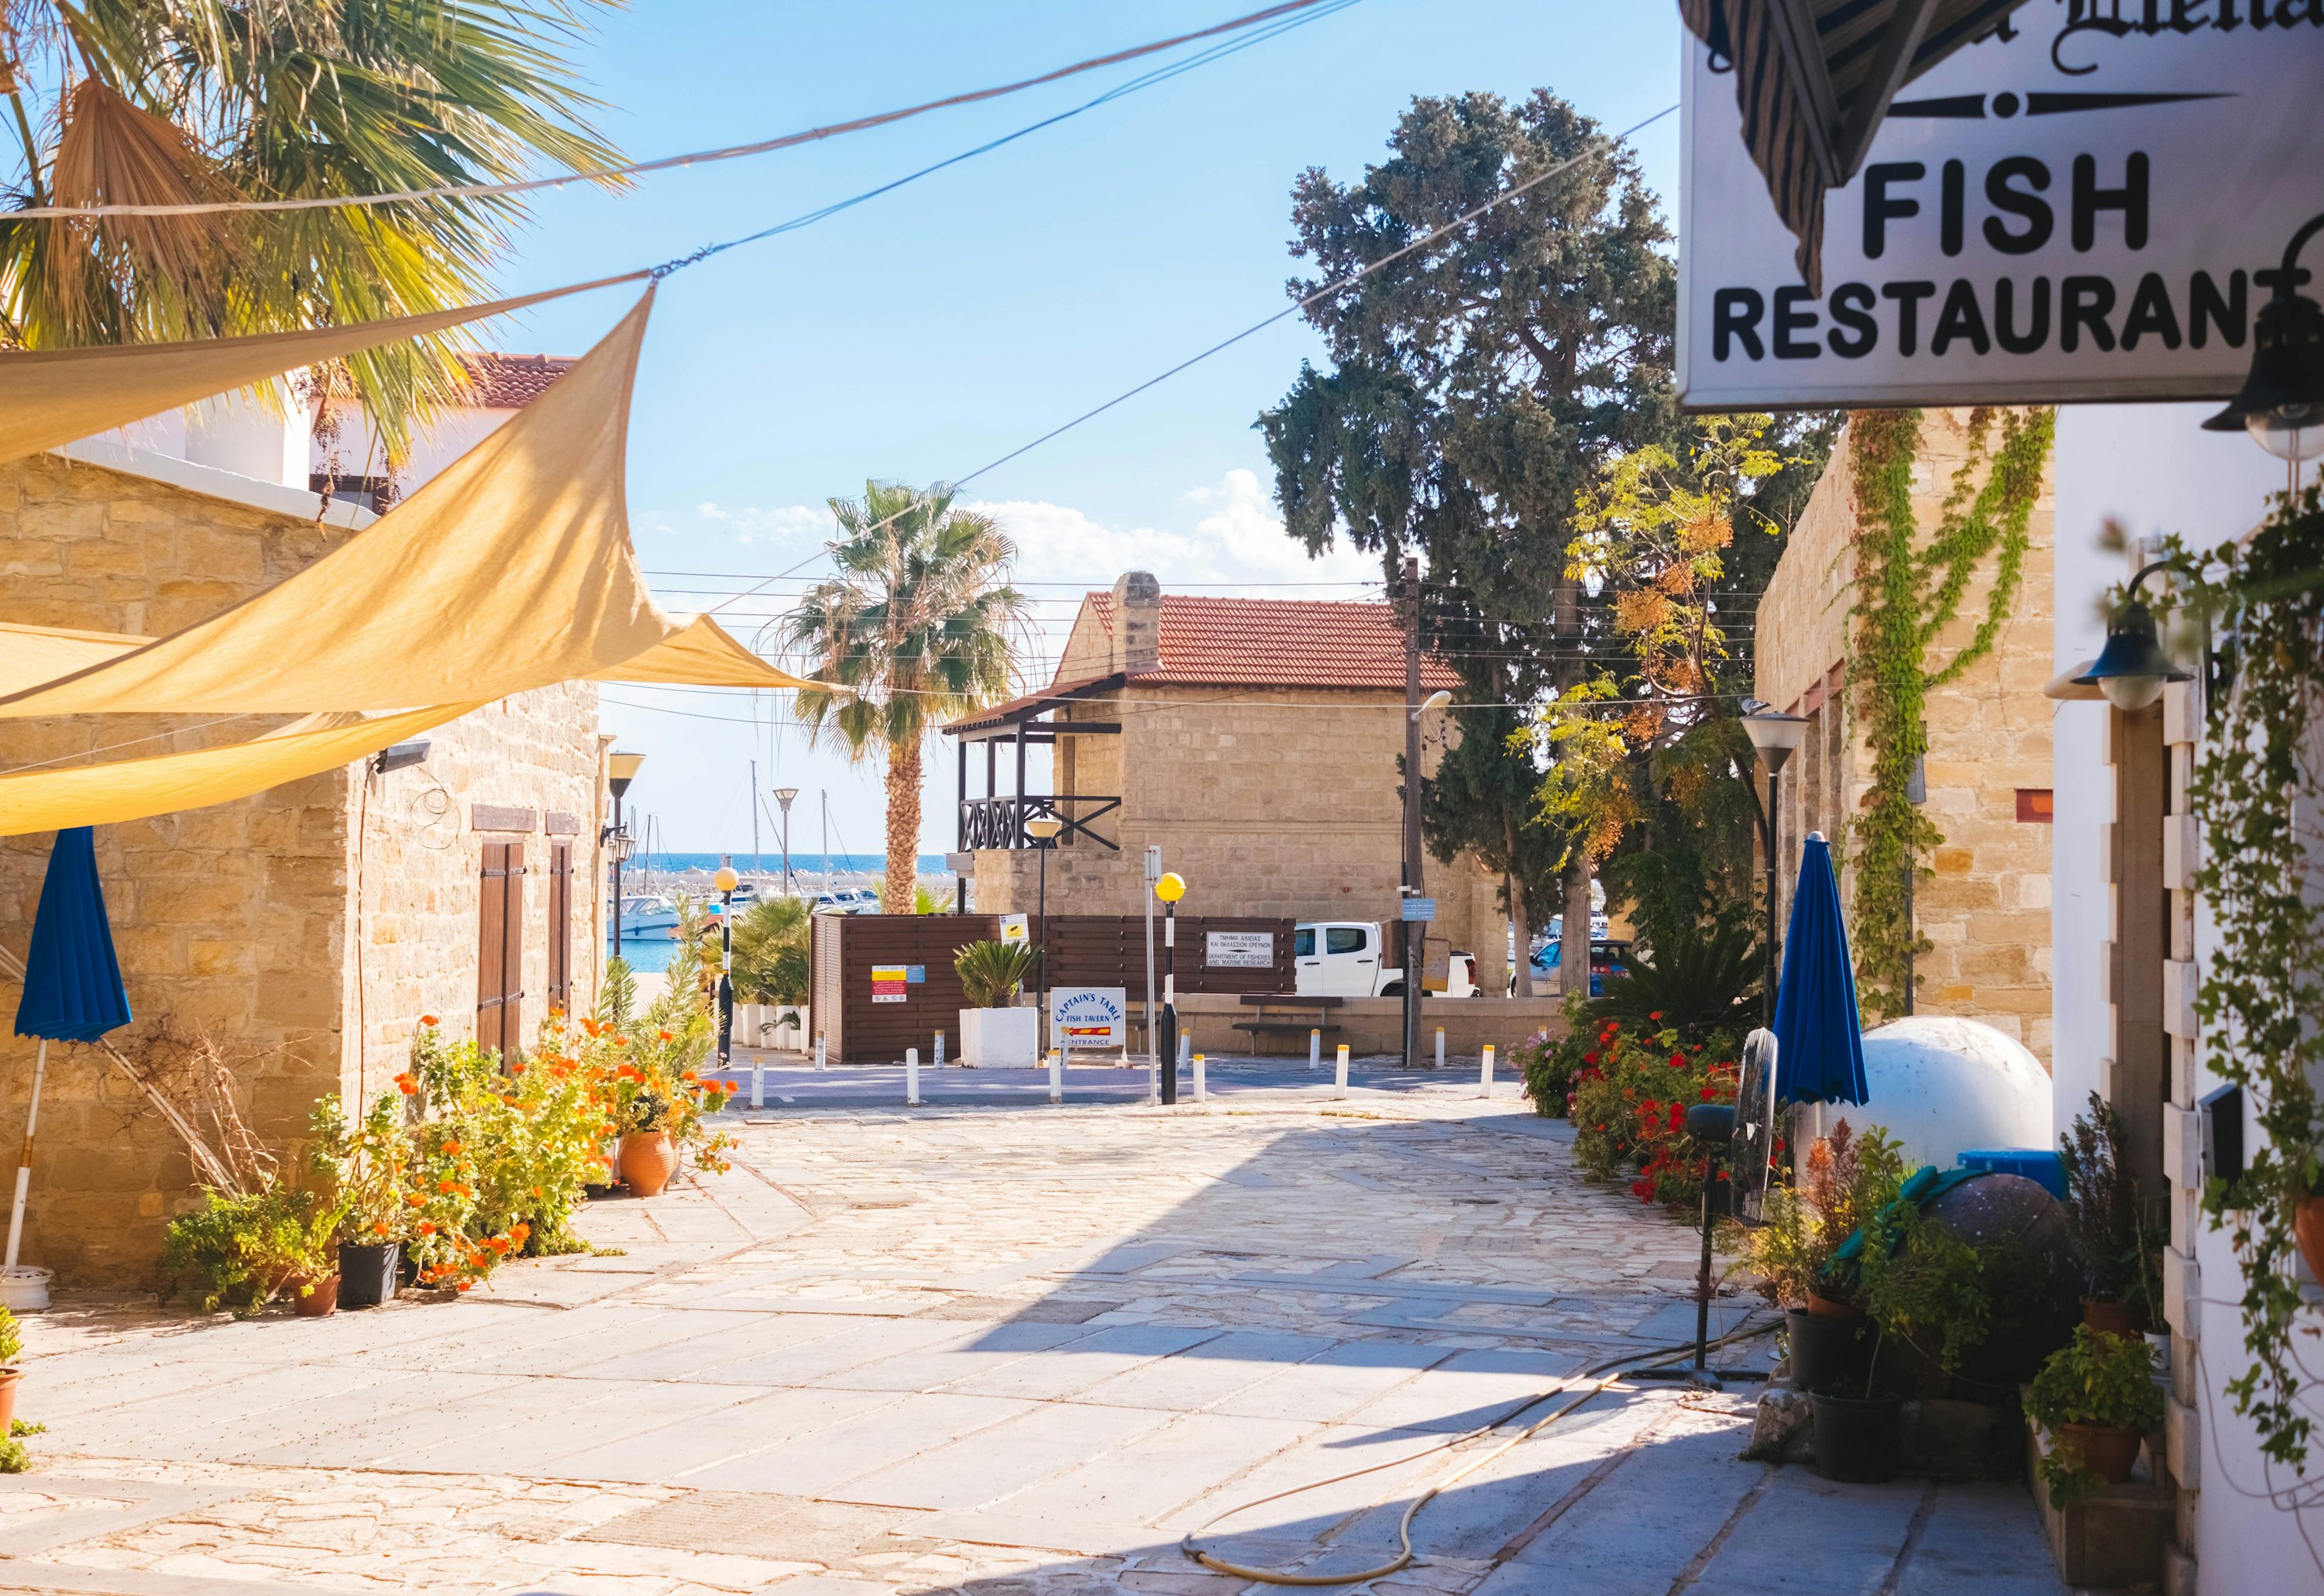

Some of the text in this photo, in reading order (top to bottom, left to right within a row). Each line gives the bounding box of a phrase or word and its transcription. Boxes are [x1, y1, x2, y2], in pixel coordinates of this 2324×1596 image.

[1863, 151, 2150, 260] FISH
[1055, 993, 1121, 1022] CAPTAIN'S TABLE
